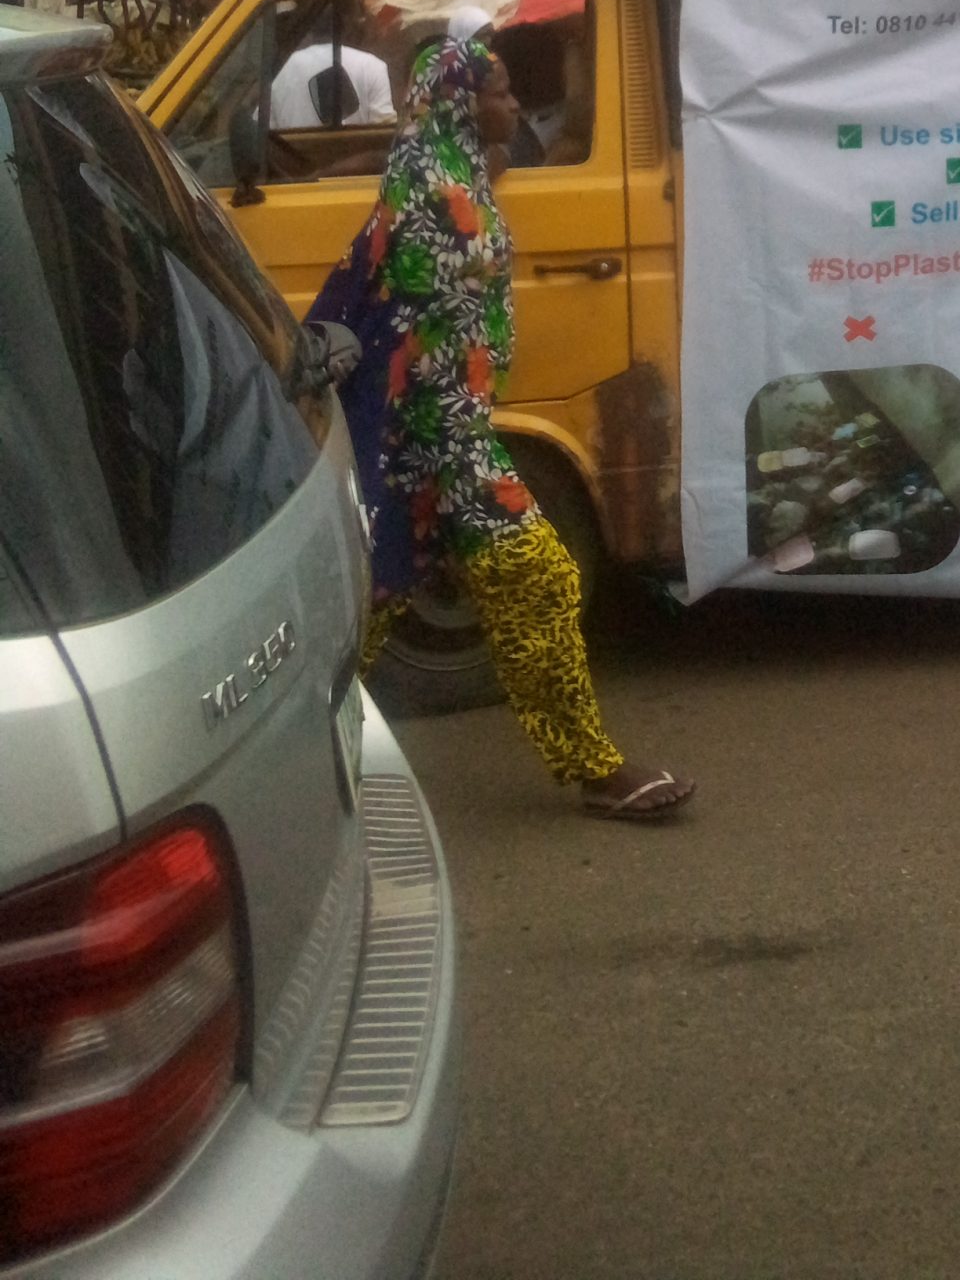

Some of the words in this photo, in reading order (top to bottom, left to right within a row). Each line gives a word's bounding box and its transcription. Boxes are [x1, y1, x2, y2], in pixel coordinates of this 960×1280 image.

[827, 15, 867, 35] Tel:
[875, 15, 927, 35] 0810
[880, 125, 931, 147] Use
[911, 200, 958, 225] Sell
[200, 672, 249, 733] ML
